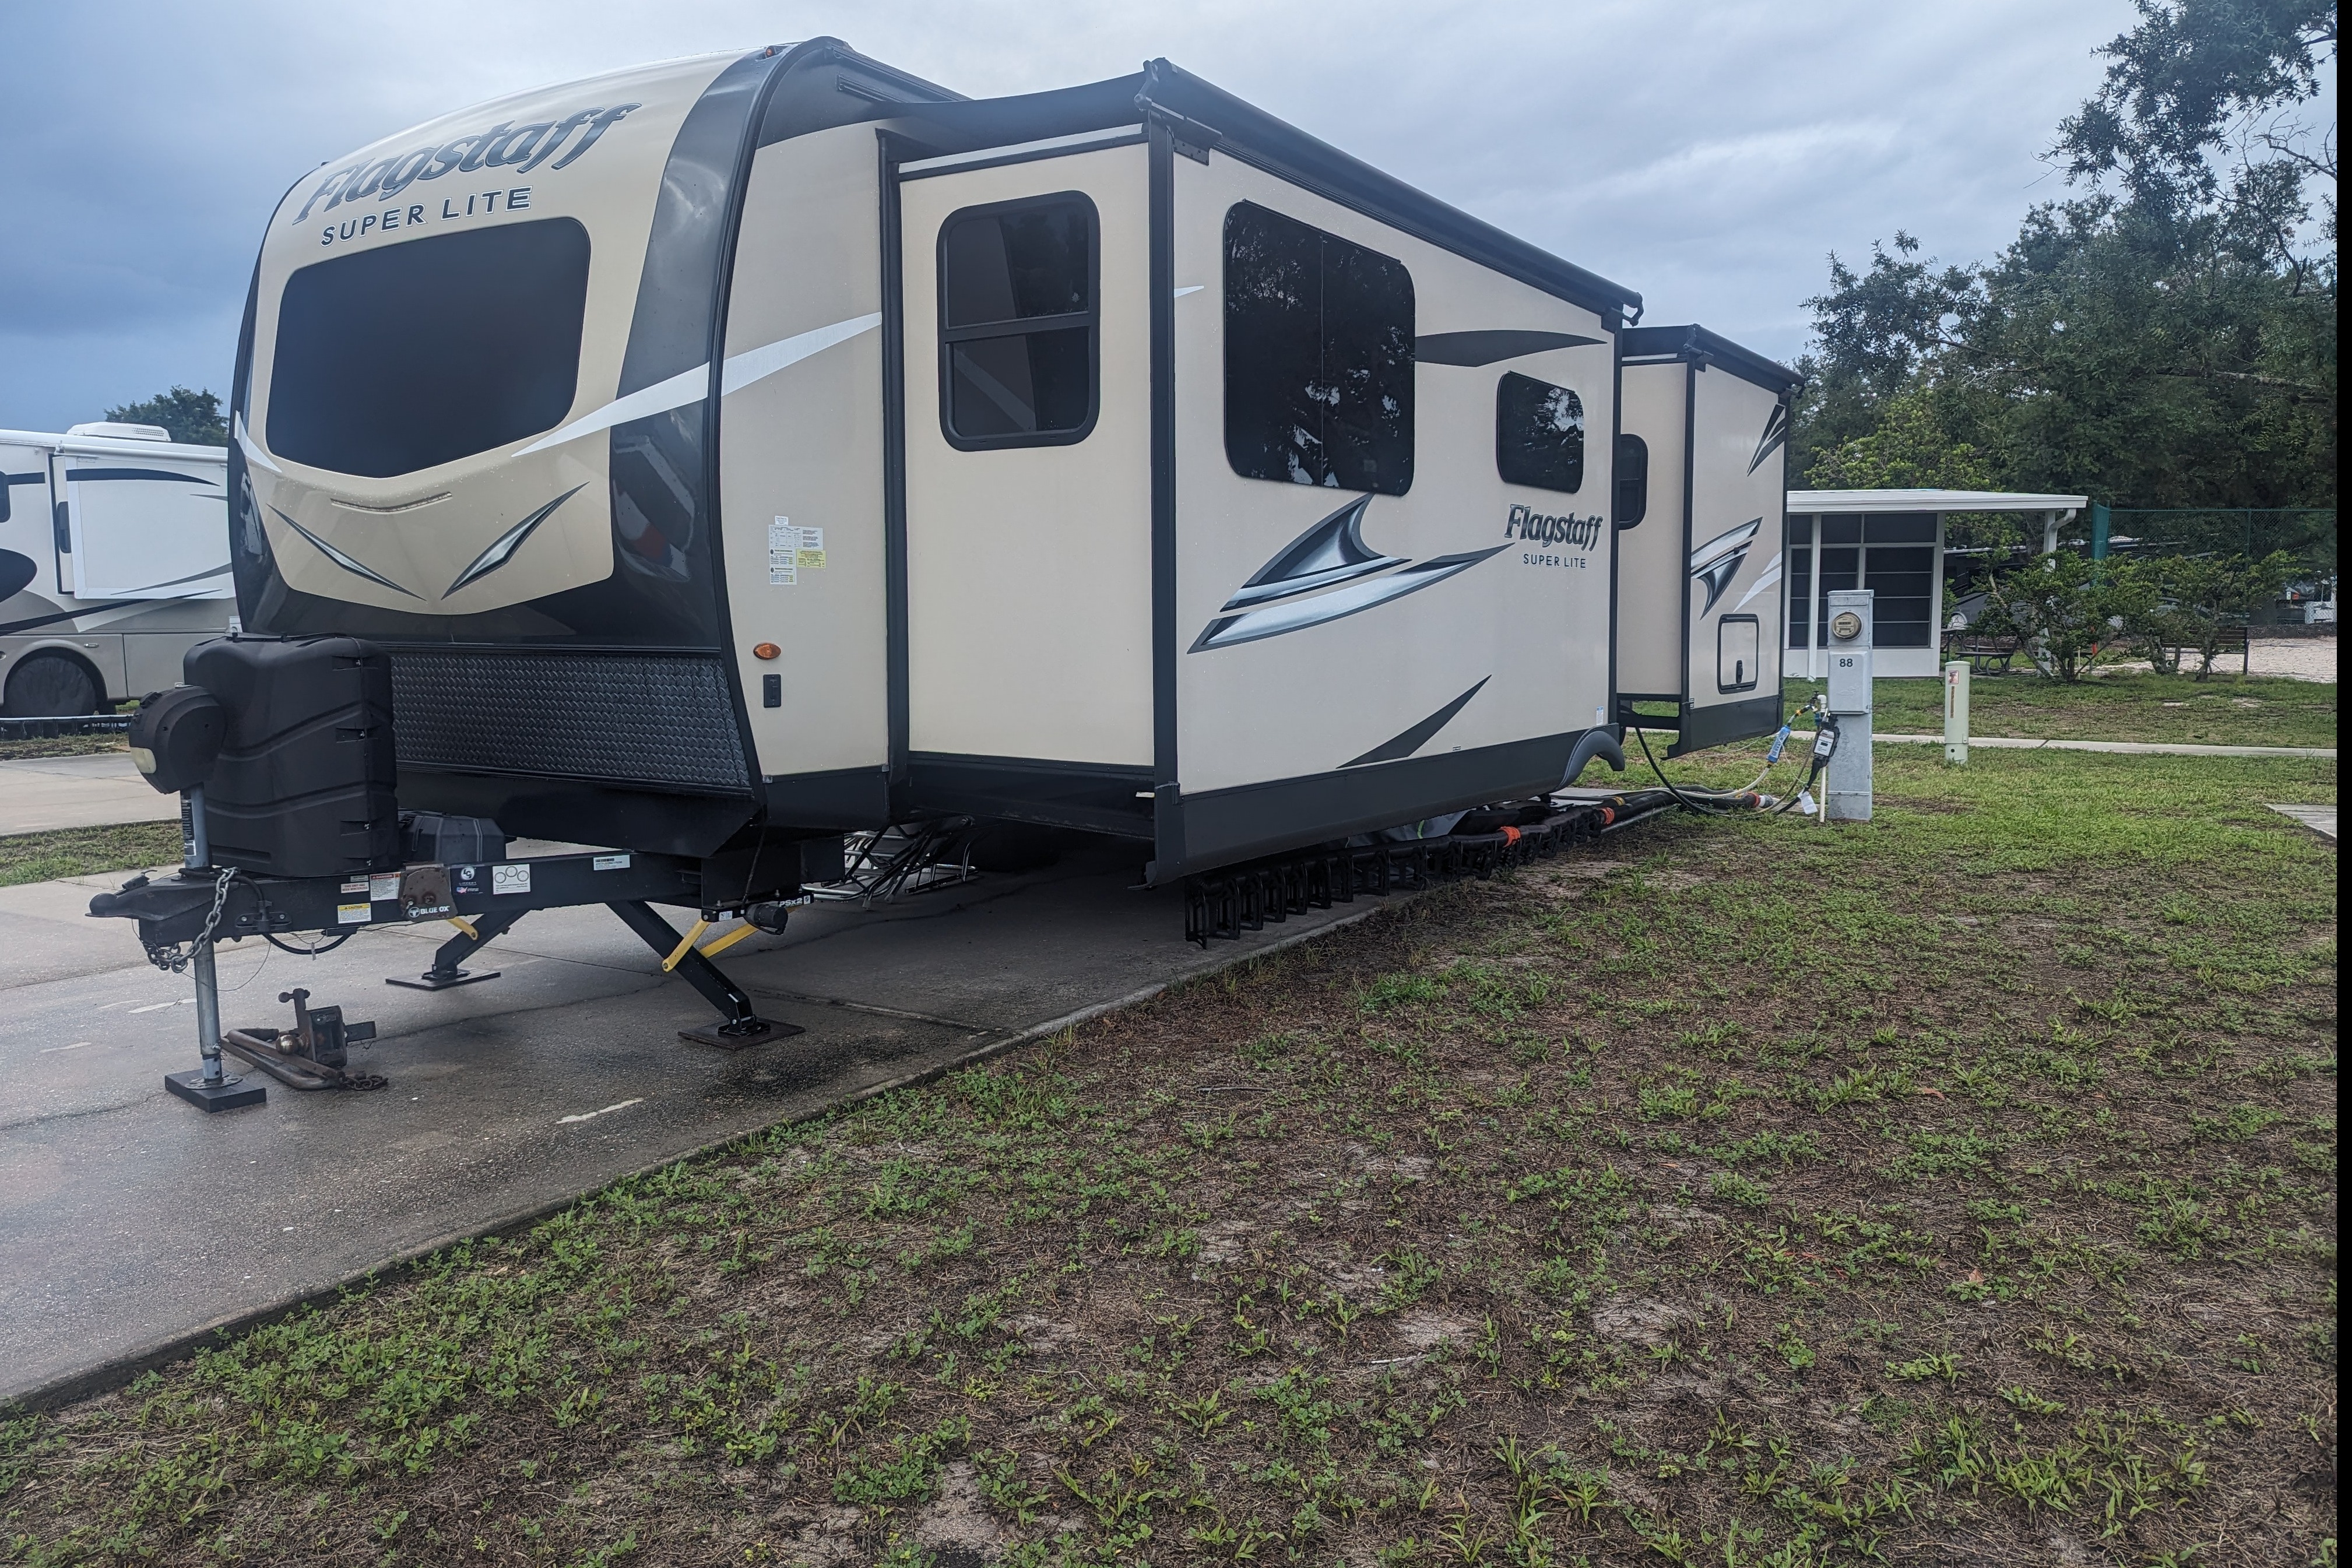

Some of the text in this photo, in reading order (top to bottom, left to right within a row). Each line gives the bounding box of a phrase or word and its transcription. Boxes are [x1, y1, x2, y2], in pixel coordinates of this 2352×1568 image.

[291, 102, 642, 226] Flagstaff
[320, 185, 533, 248] SUPER LITE
[1504, 504, 1603, 551] Flagstaff
[1523, 553, 1587, 569] SUPER LITE
[1839, 658, 1853, 667] 88
